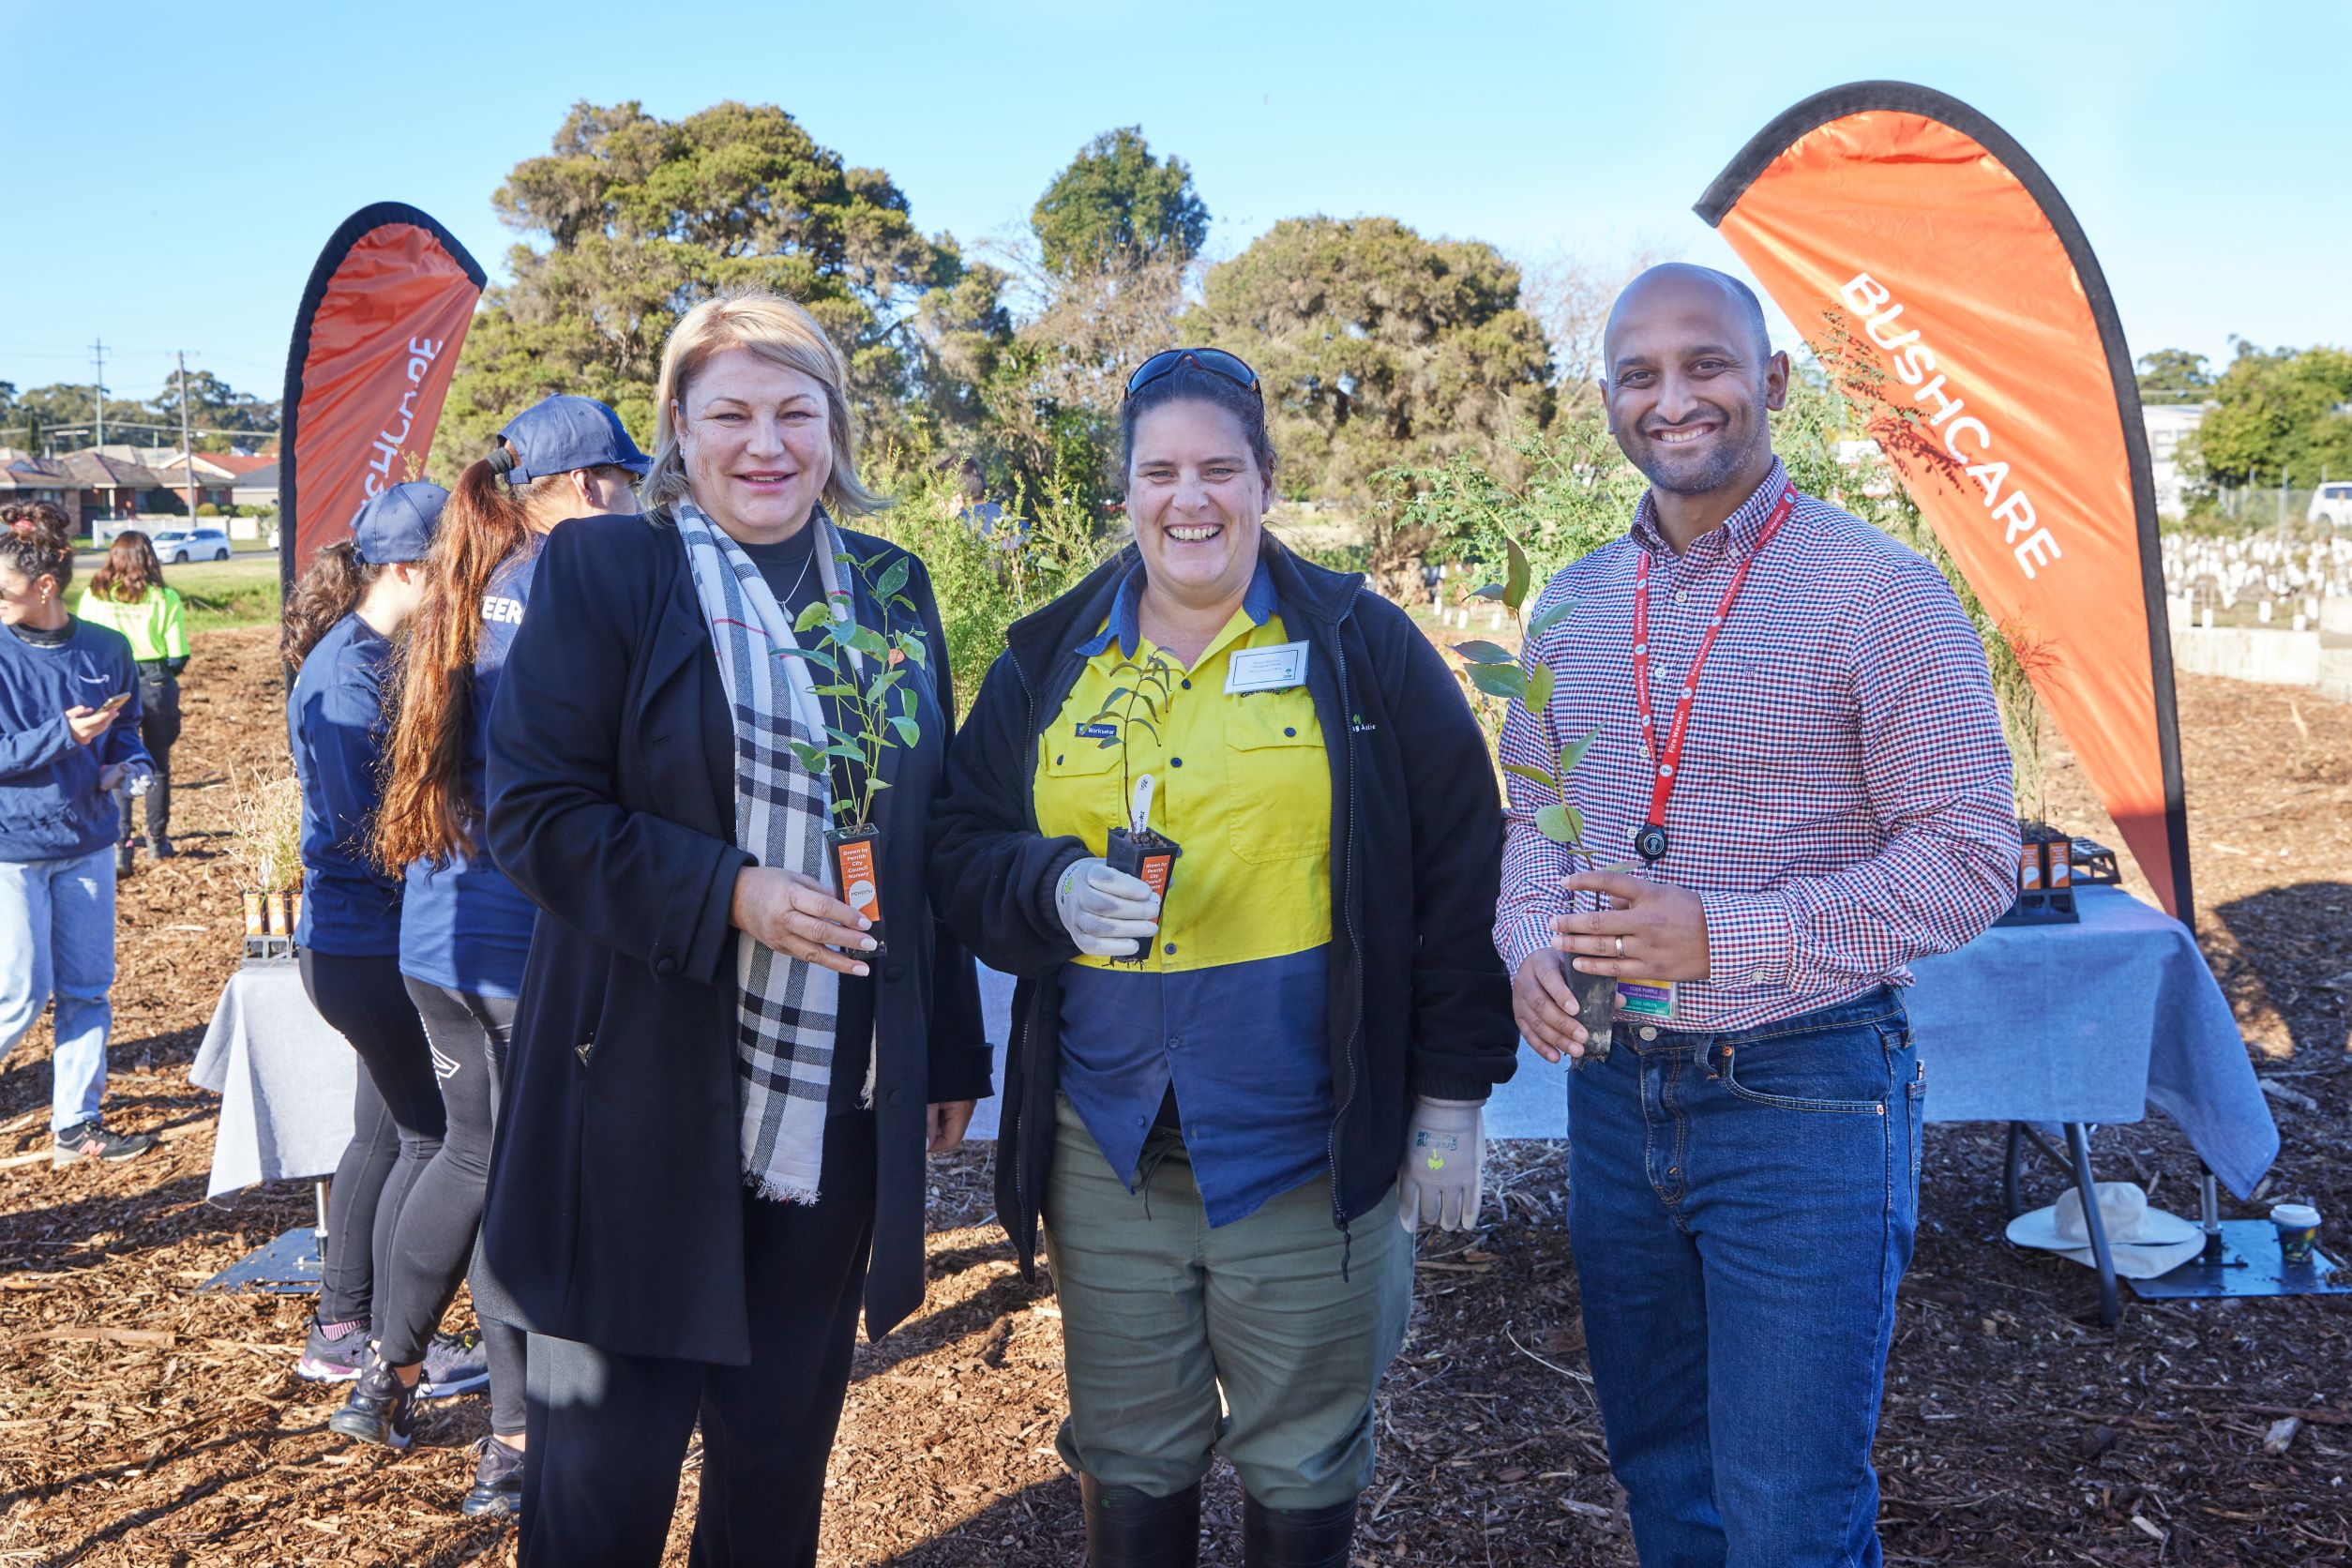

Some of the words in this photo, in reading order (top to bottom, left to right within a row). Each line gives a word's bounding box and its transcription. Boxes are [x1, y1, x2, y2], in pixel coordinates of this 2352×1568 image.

[1840, 273, 2061, 579] BUSHCARE
[1771, 509, 1786, 532] Warden
[1722, 591, 1731, 606] Fire
[1729, 567, 1743, 592] Warden
[1691, 660, 1699, 676] Fire
[1696, 637, 1711, 661] Warden
[1088, 727, 1115, 735] Workwear
[1667, 737, 1677, 754] Fire
[1673, 710, 1684, 738] Warden
